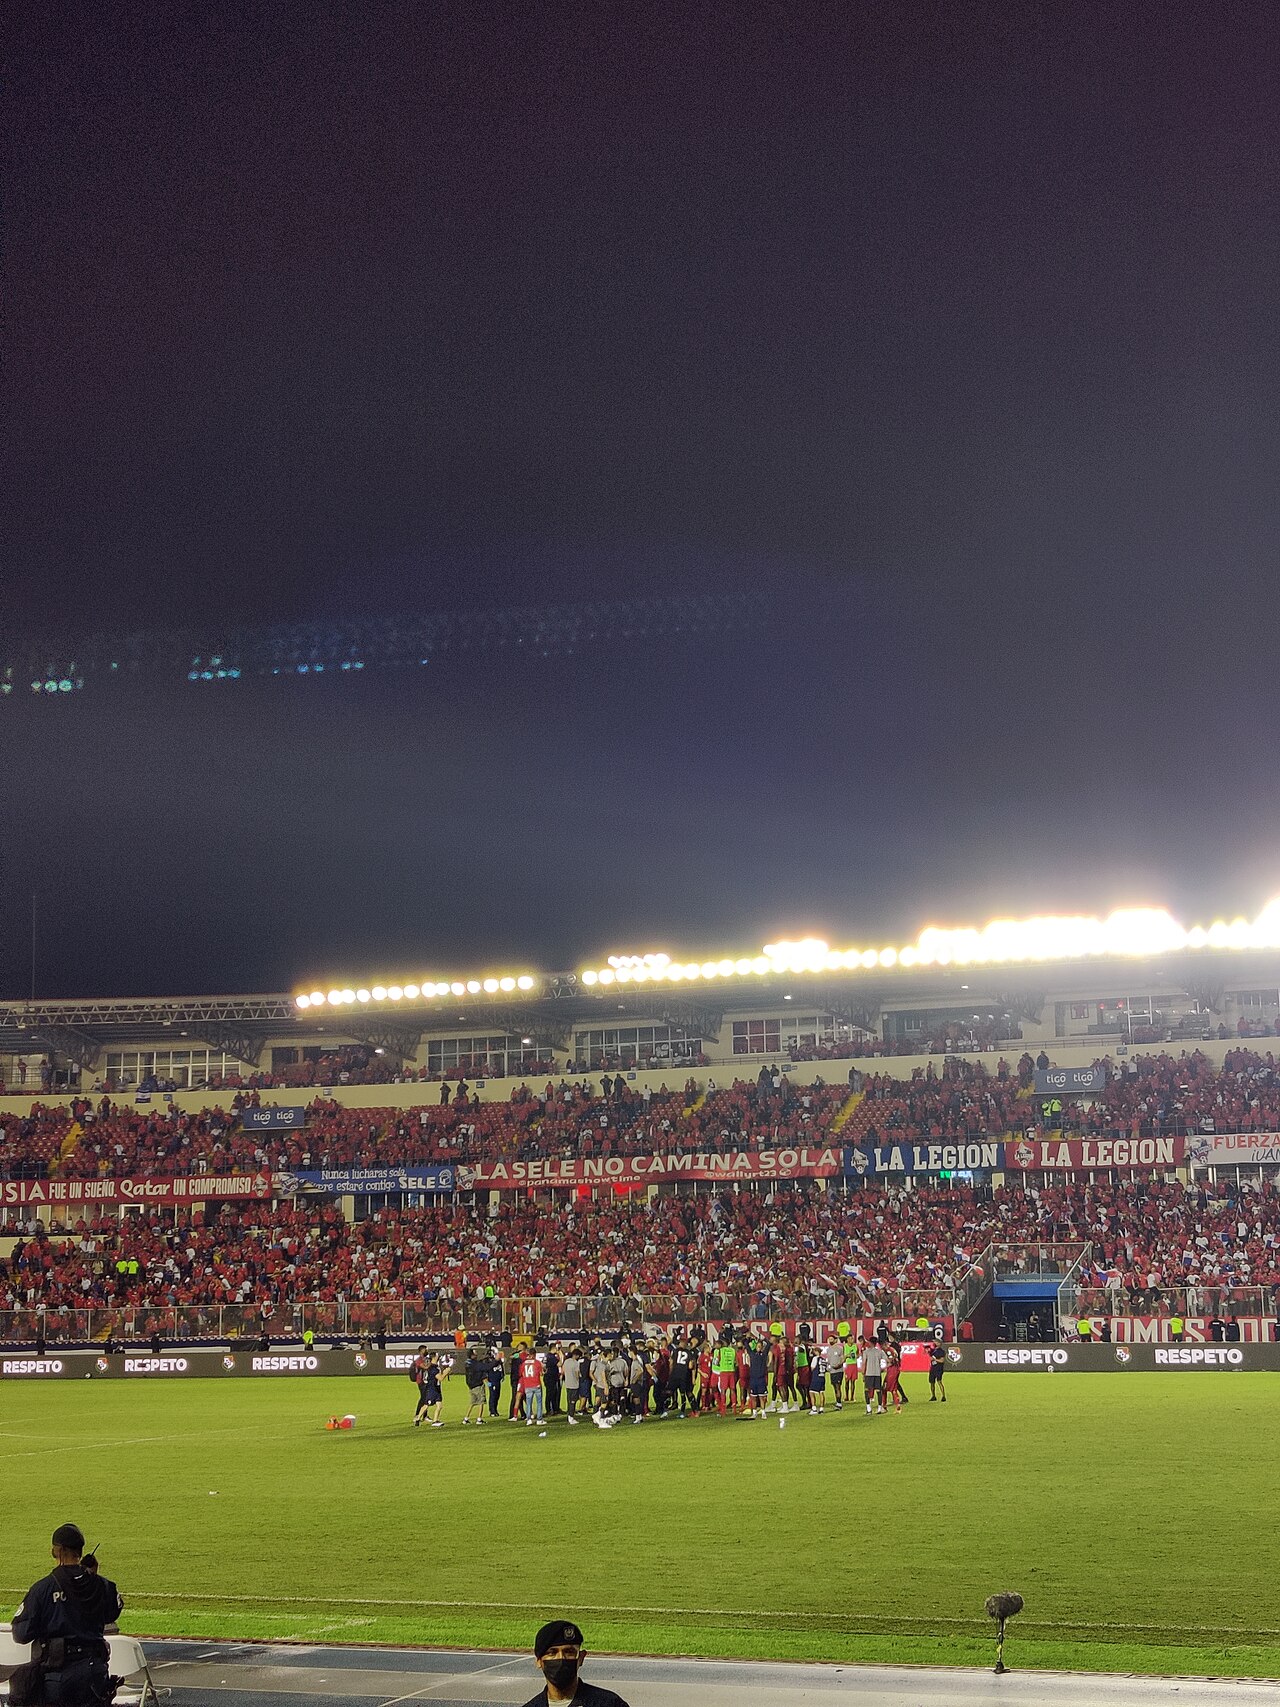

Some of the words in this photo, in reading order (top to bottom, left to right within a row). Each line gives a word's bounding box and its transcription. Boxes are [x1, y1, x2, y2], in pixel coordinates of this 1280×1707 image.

[873, 1146, 904, 1172] LA
[912, 1143, 998, 1171] LEGION
[1040, 1141, 1072, 1167] LA
[1081, 1138, 1174, 1166] LEGION
[475, 1162, 508, 1180] LA
[512, 1159, 576, 1178] SELE
[583, 1156, 625, 1176] NO
[631, 1151, 752, 1174] CAMINA
[321, 1170, 350, 1180] Nunca
[49, 1182, 66, 1199] FUE
[69, 1182, 82, 1198] UN
[120, 1179, 170, 1198] Qatar
[173, 1179, 186, 1195] UN
[189, 1177, 251, 1195] COMPROMISO
[366, 1180, 396, 1192] contigo
[399, 1176, 436, 1189] SELE
[252, 1357, 318, 1370] RESPETO
[677, 1351, 688, 1364] 12
[984, 1349, 1068, 1364] RESPETO
[1155, 1348, 1243, 1364] RESPETO
[3, 1360, 62, 1373] RESPETO
[125, 1359, 187, 1371] RESPETO
[524, 1365, 534, 1378] 14
